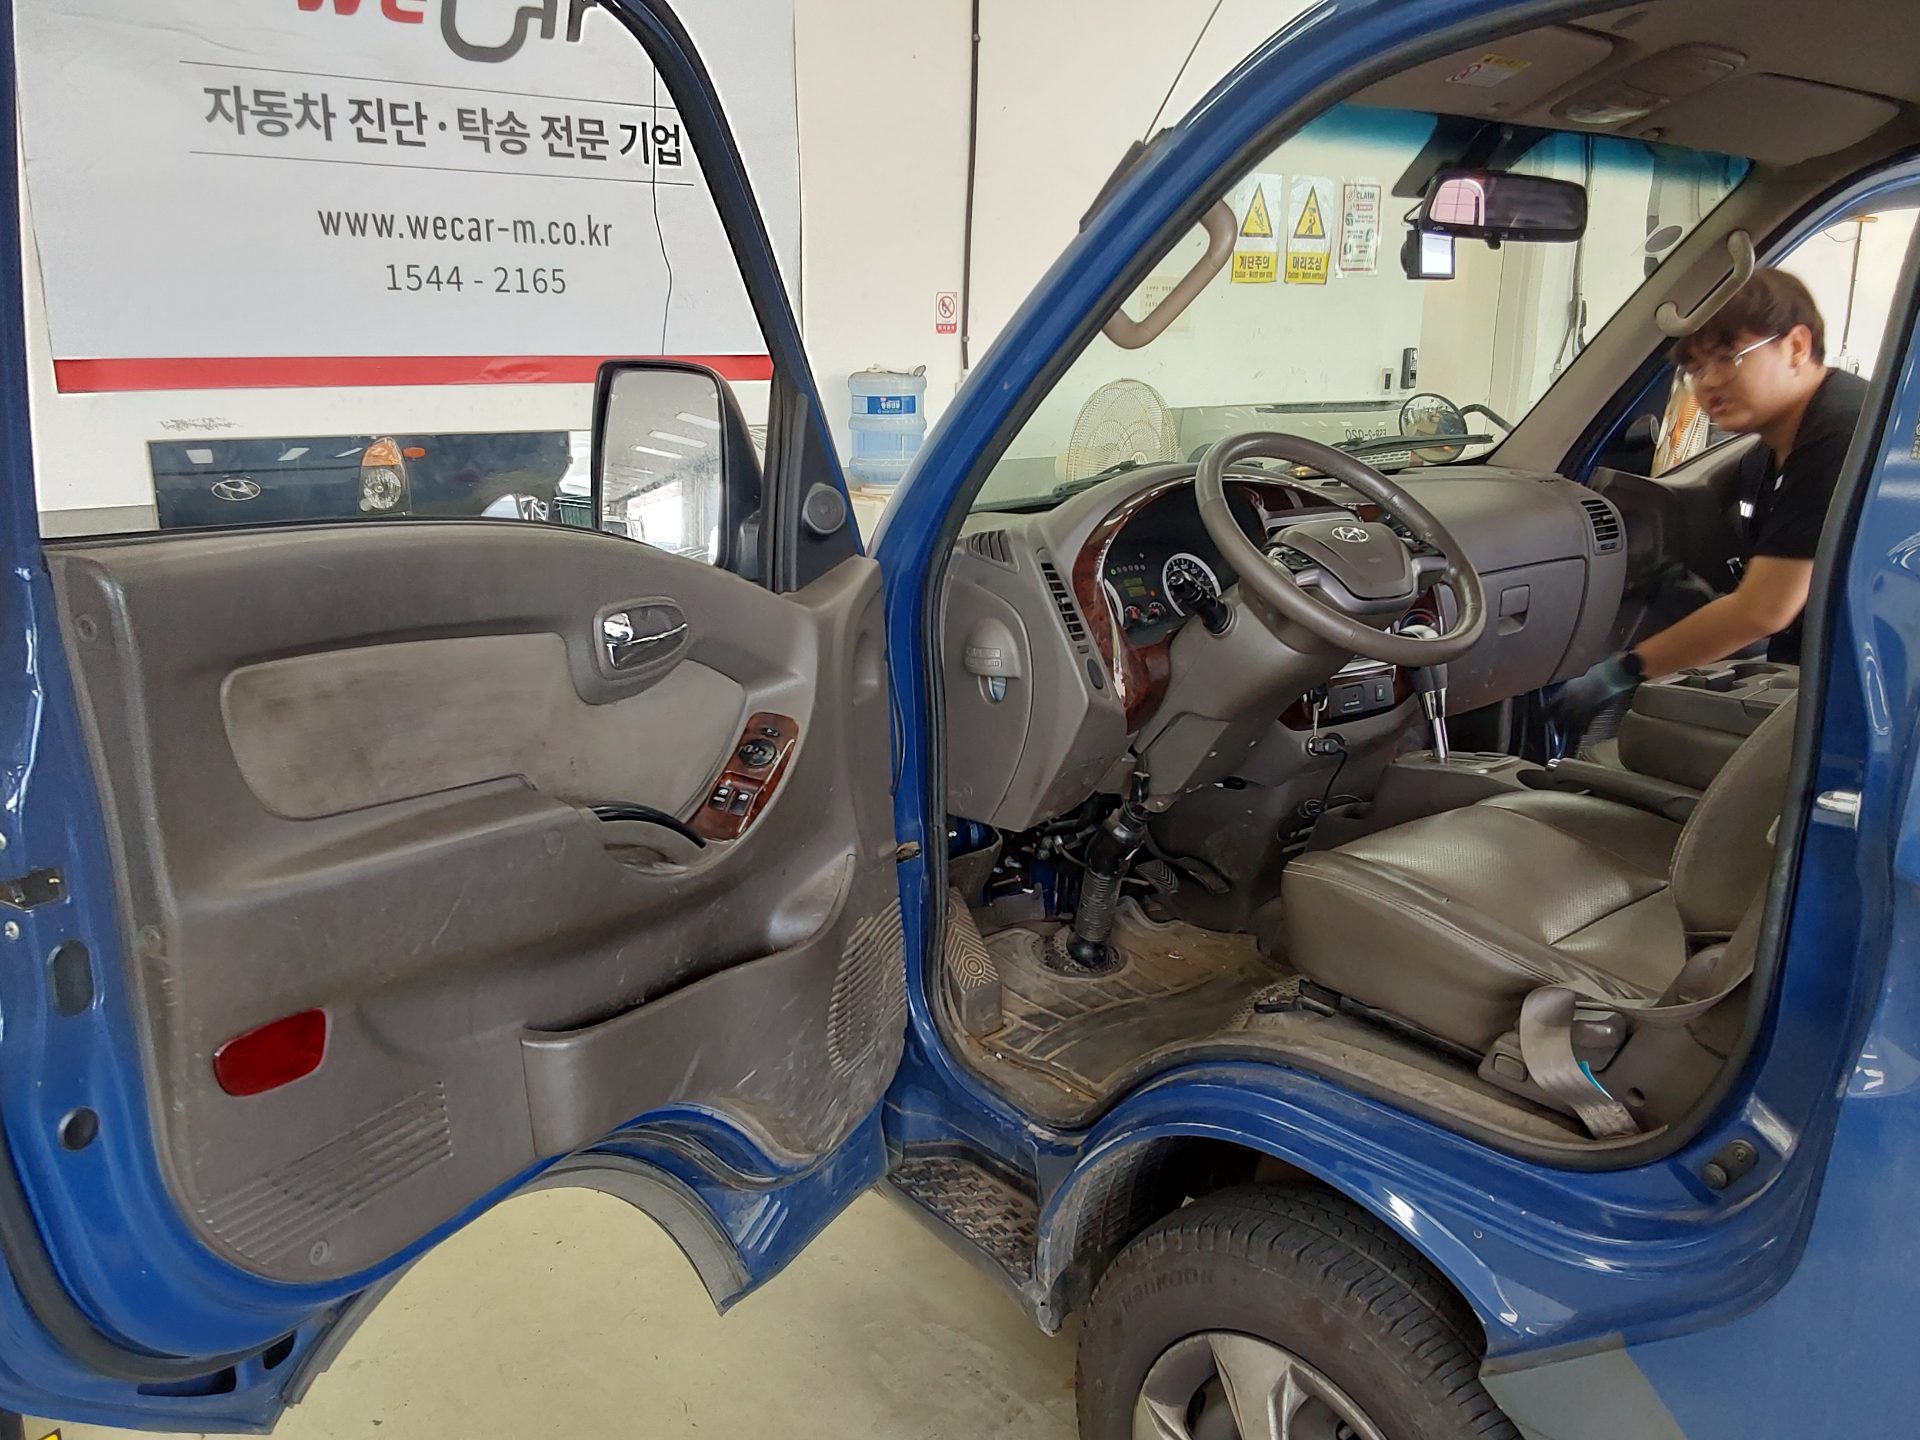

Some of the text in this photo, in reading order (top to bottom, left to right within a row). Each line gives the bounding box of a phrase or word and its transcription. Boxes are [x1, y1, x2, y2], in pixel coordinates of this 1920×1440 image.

[203, 85, 337, 142] 자동차
[540, 115, 610, 161] 전문
[619, 121, 683, 167] 기업
[317, 210, 613, 247] www.wecar-m.co.kr
[386, 264, 464, 293] 1544
[493, 266, 567, 295] 2165
[1292, 256, 1323, 271] 머리조심
